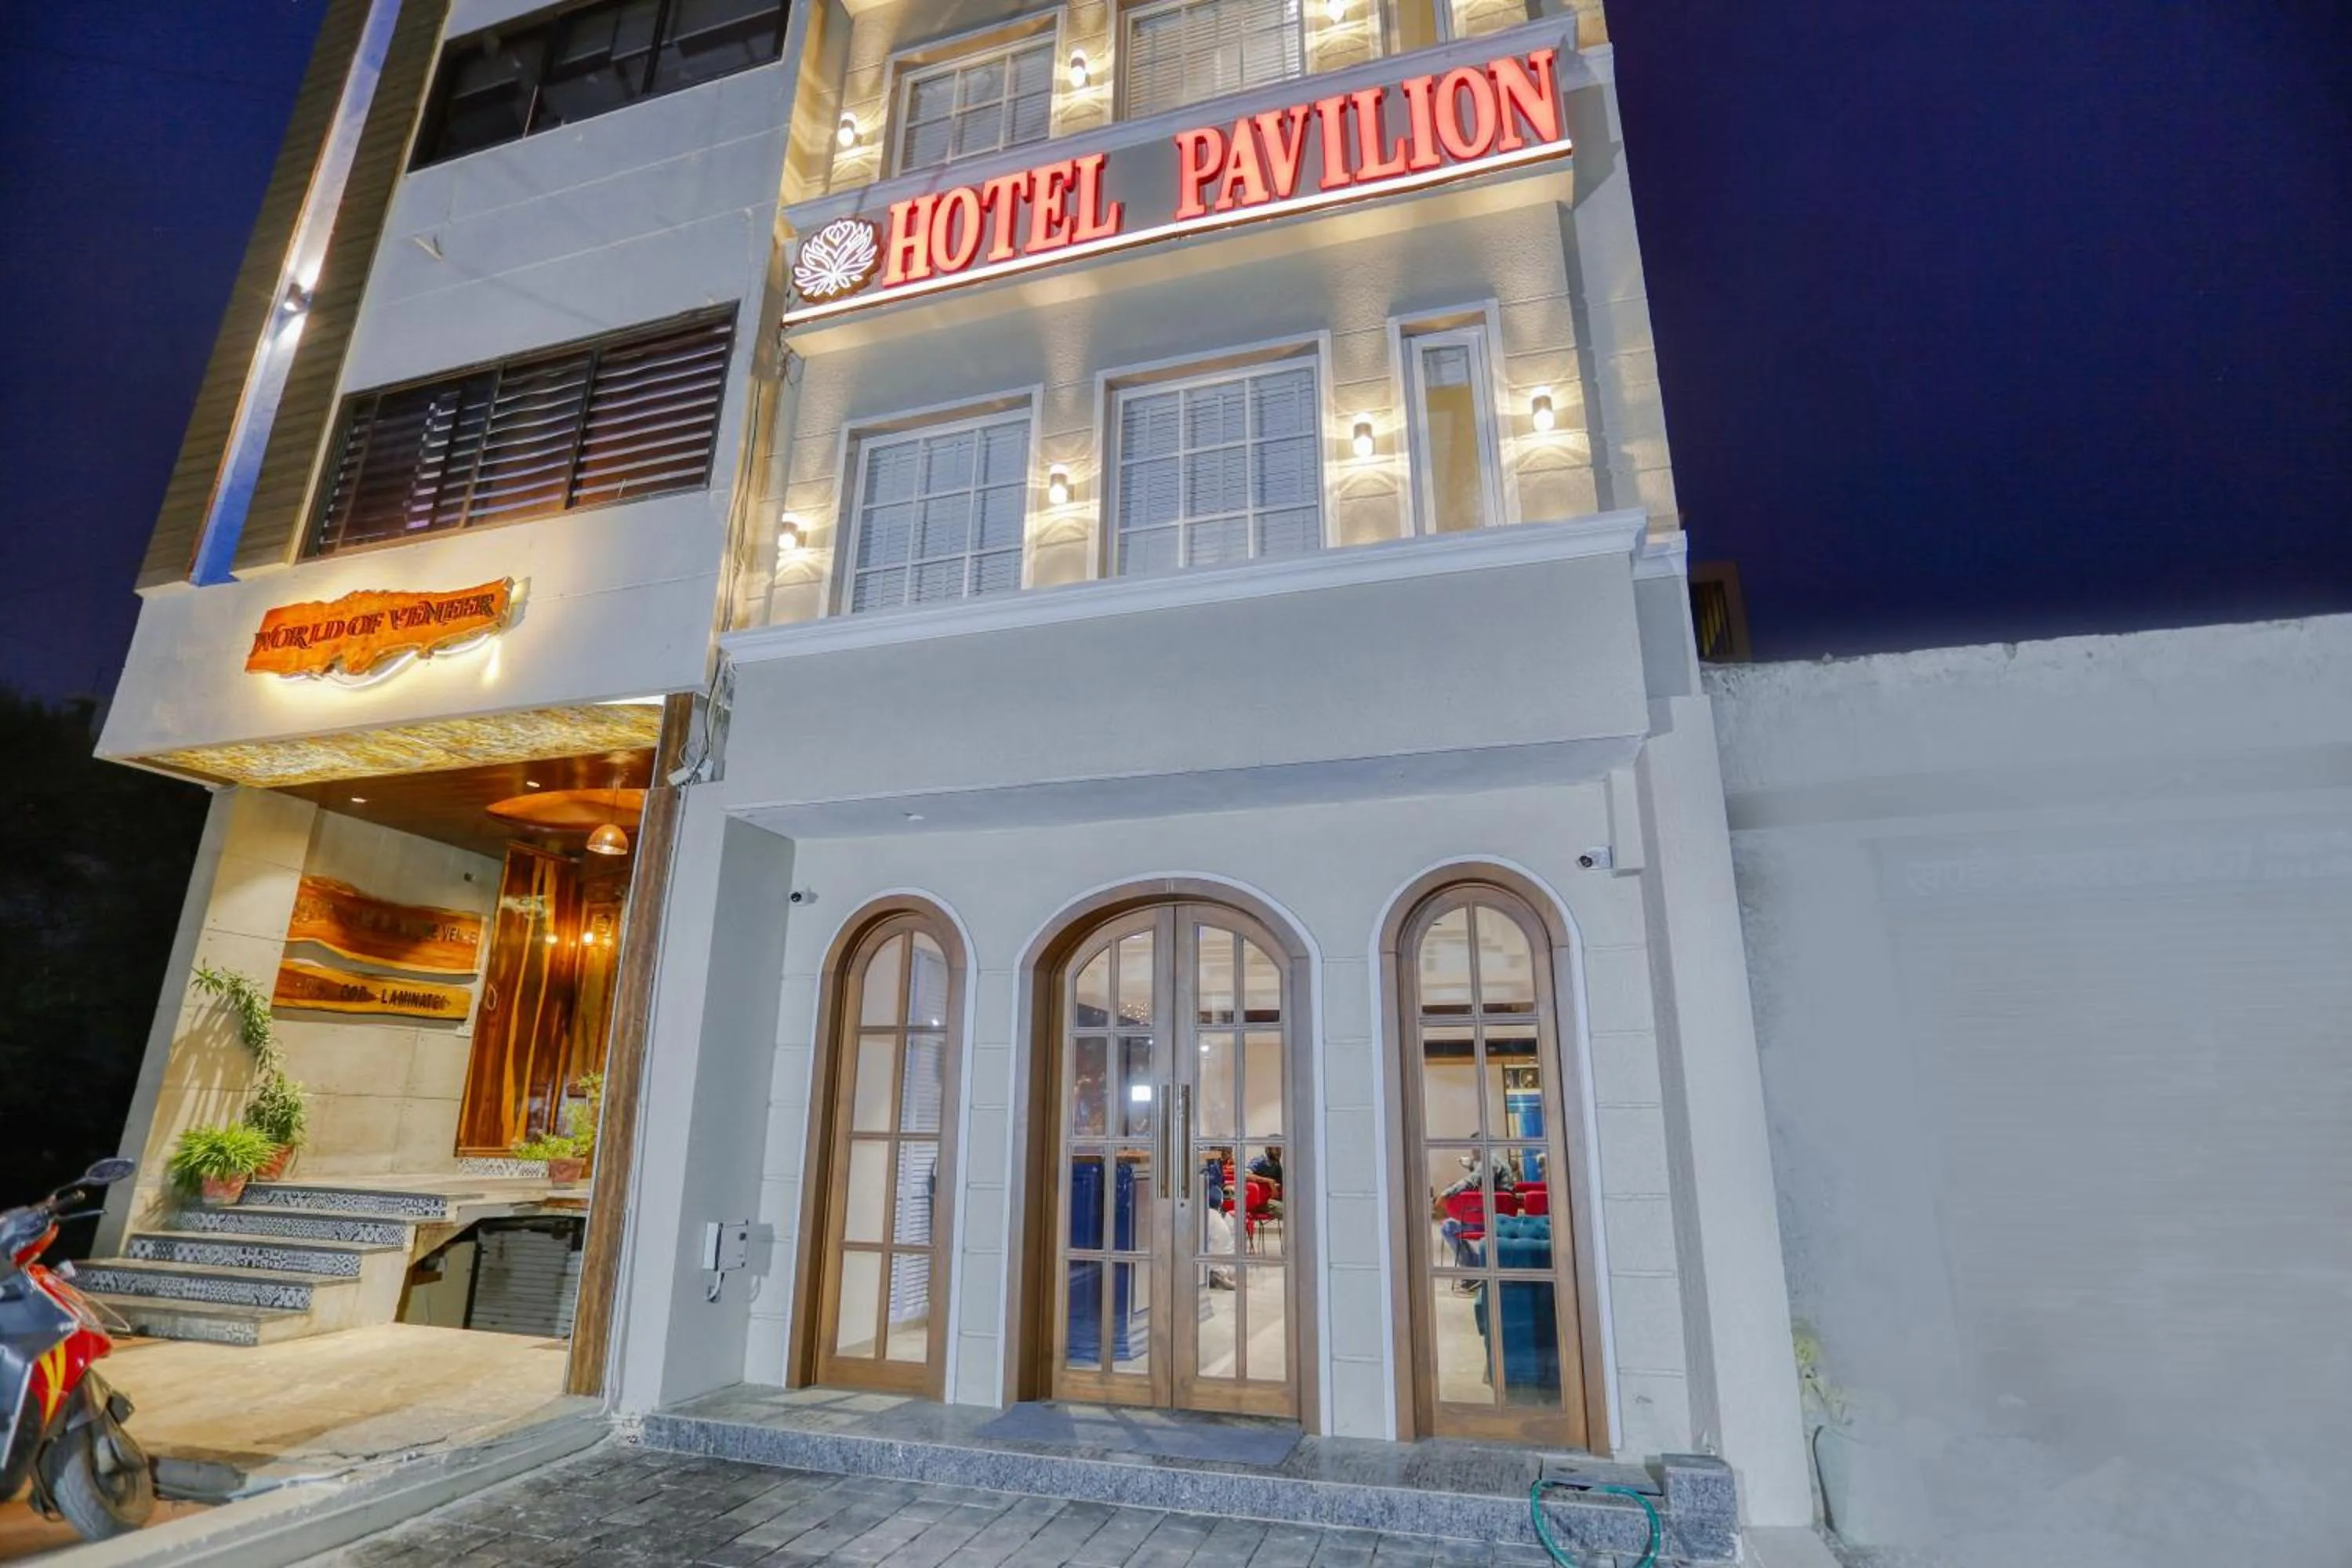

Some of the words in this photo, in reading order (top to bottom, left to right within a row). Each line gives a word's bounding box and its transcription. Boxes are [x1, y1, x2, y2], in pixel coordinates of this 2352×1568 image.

[881, 152, 1121, 287] HOTEL
[1174, 49, 1561, 221] PAVILION
[255, 620, 345, 652] WORLD
[347, 612, 385, 636] OF
